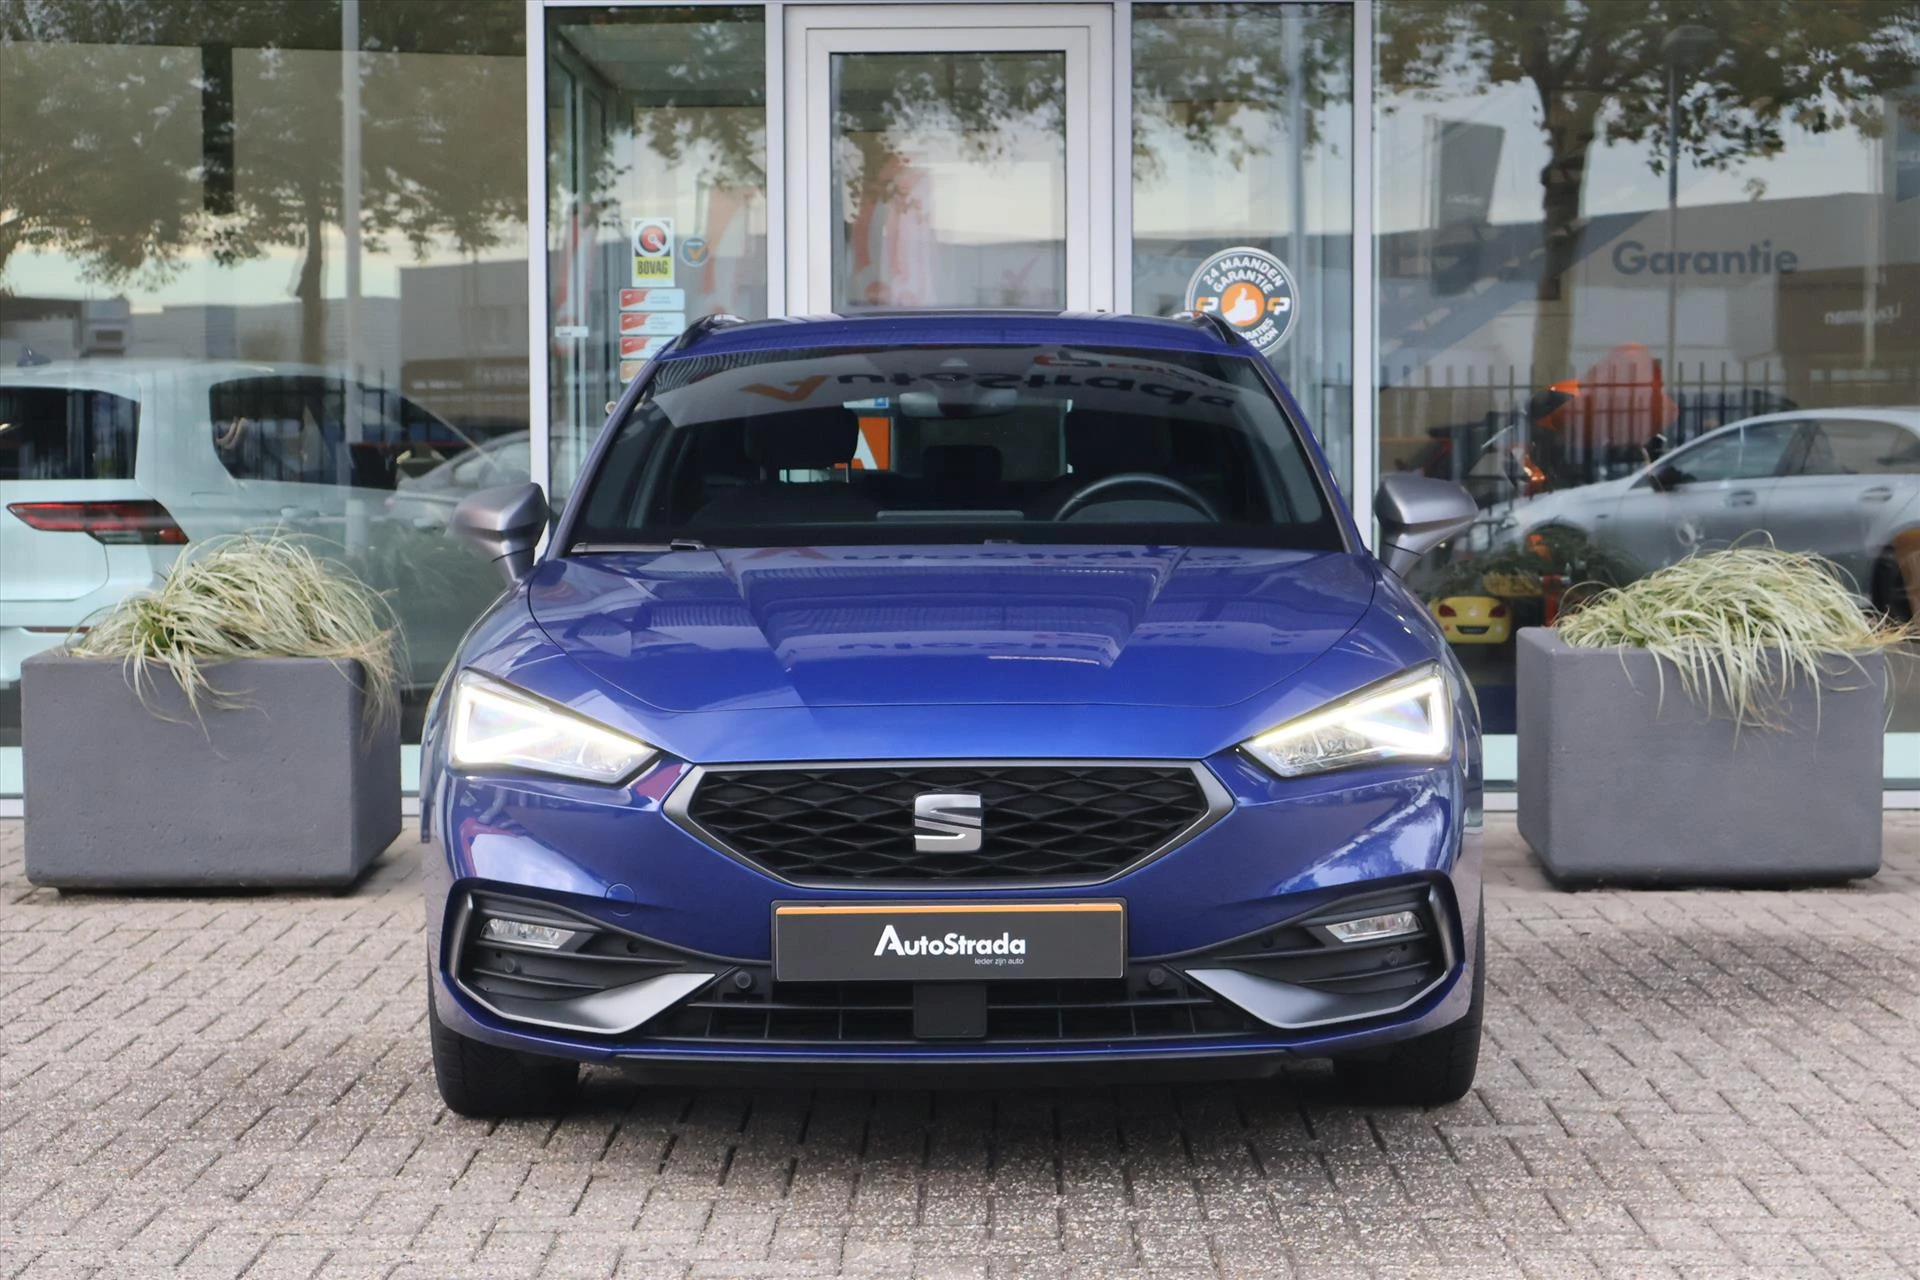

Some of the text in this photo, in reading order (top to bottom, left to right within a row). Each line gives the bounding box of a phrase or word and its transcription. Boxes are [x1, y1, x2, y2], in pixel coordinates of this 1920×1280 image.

[637, 260, 669, 275] BOVAG
[1203, 256, 1285, 287] 24 MAANDEN
[1612, 239, 1799, 276] Garantie
[1212, 269, 1275, 294] GARANTIE
[873, 924, 1026, 957] AutoStrada
[994, 957, 1007, 967] zijn
[1008, 958, 1025, 966] auto
